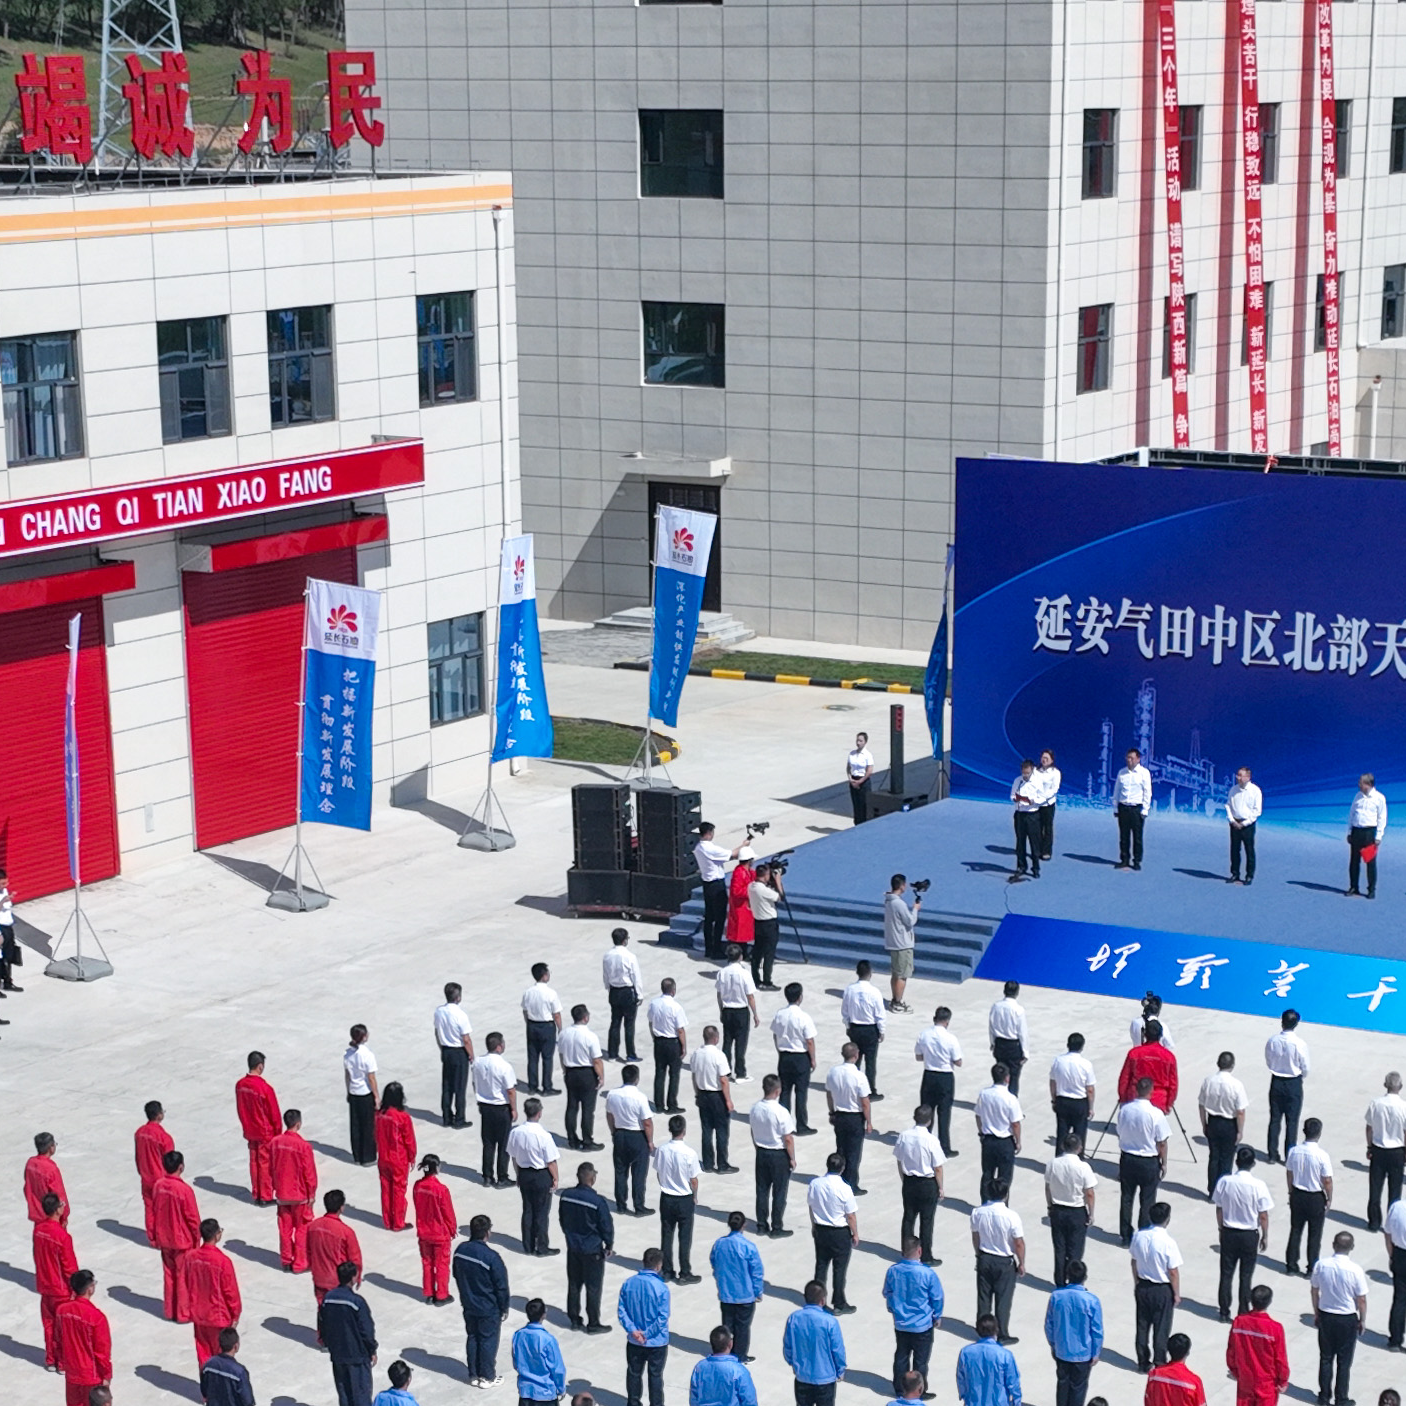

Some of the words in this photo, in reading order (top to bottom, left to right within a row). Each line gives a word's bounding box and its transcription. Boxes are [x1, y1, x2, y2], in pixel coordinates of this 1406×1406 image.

[16, 50, 385, 164] 竭诚为民
[1244, 106, 1261, 201] 行稳致远
[1247, 218, 1264, 310] 不怕困难
[1249, 325, 1266, 395] 新延长
[21, 503, 101, 541] CHANG
[117, 497, 139, 526] QI
[154, 487, 203, 519] TIAN
[217, 477, 266, 509] XIAO
[279, 466, 332, 498] FANG
[324, 632, 359, 646] 延长石油
[318, 694, 336, 813] 贯彻新发展理念
[339, 668, 360, 790] 把握新发展阶段
